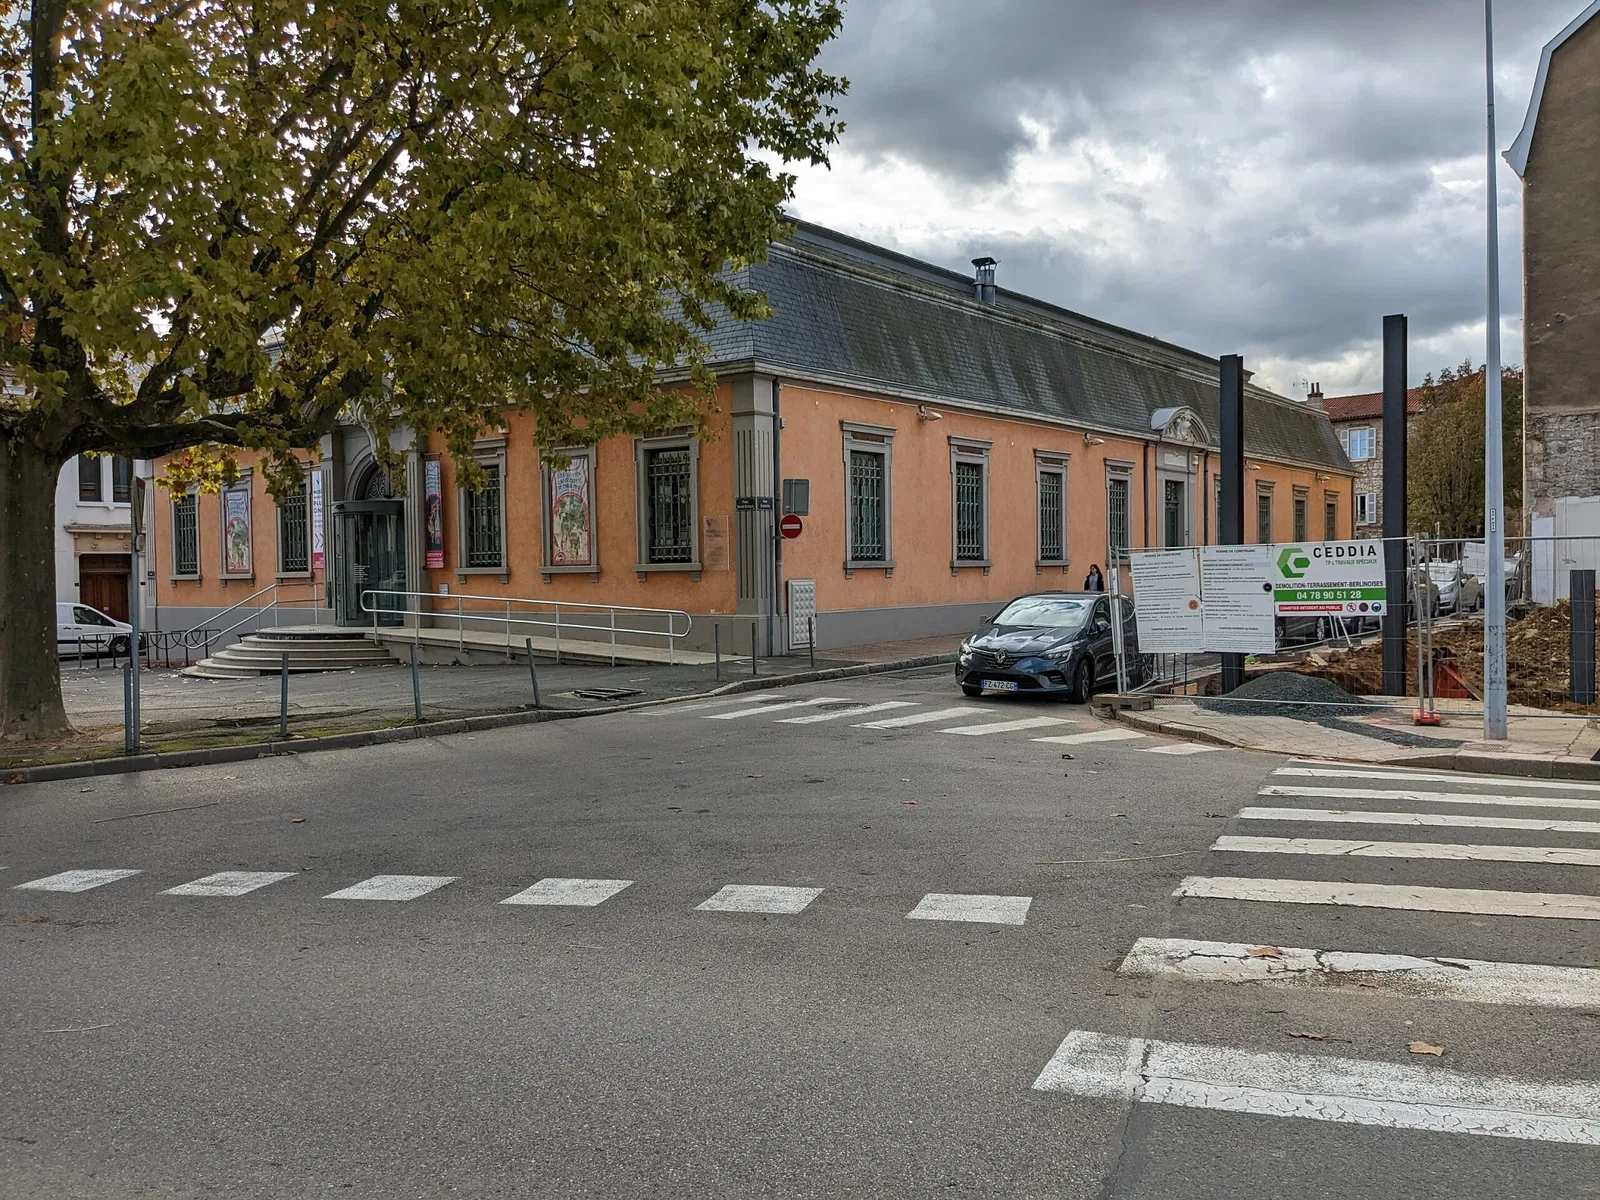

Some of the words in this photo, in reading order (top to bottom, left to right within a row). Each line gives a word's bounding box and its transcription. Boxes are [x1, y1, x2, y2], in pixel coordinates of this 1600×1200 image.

[1313, 545, 1377, 558] CEDDIA
[1296, 592, 1307, 600] 04
[1310, 591, 1321, 599] 78
[1323, 591, 1334, 599] 90
[1336, 591, 1346, 599] 51
[1350, 590, 1362, 599] 28
